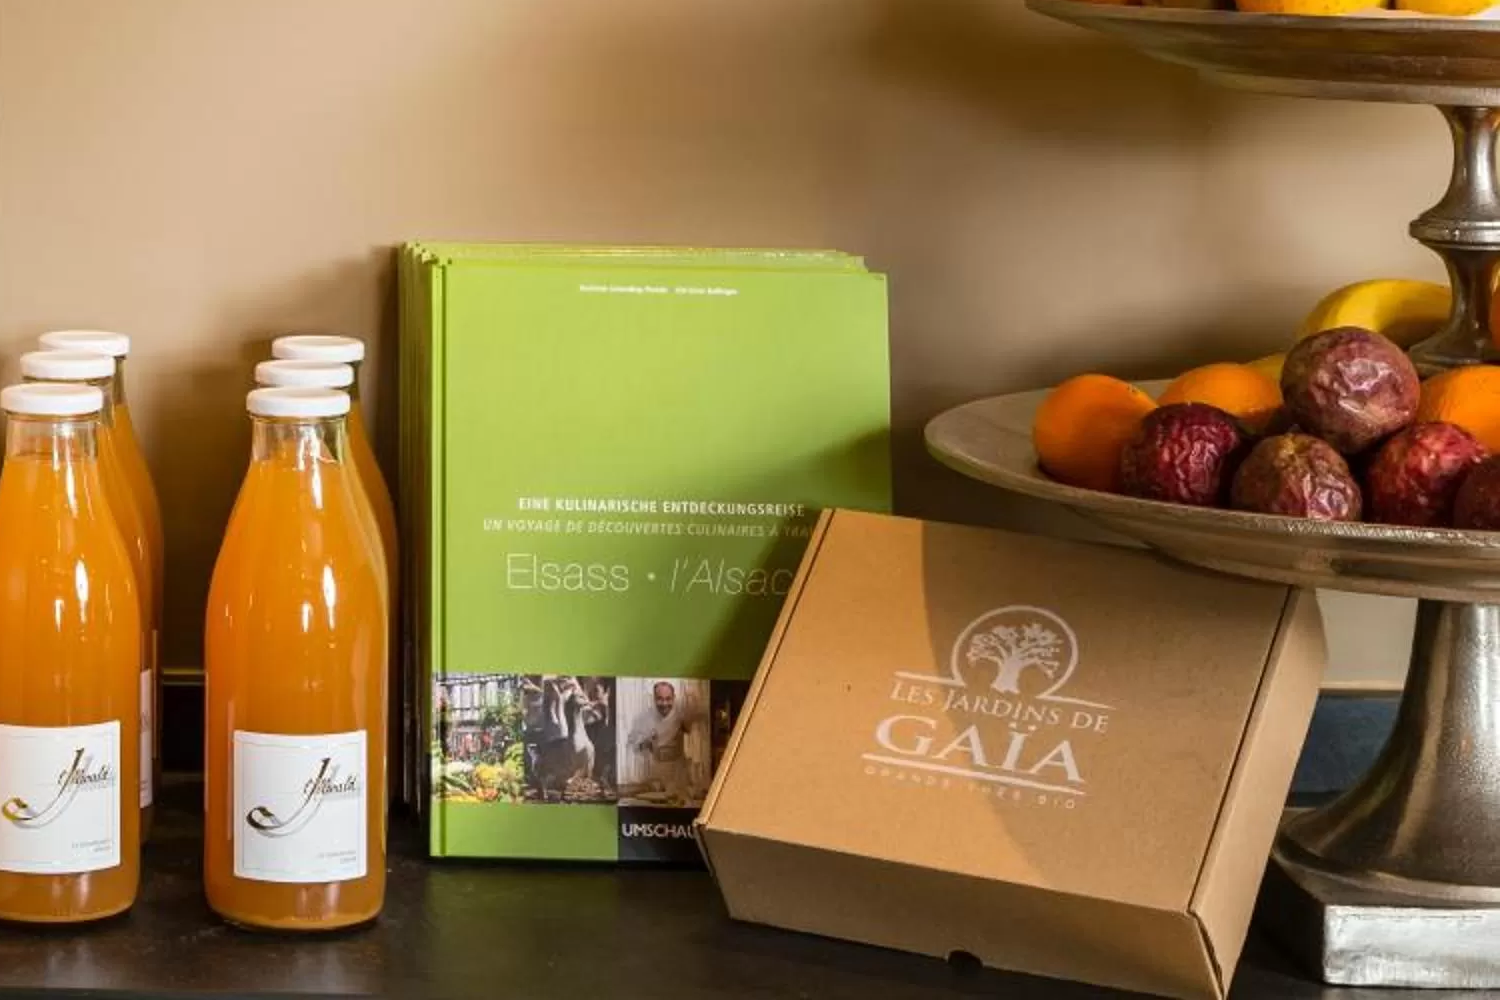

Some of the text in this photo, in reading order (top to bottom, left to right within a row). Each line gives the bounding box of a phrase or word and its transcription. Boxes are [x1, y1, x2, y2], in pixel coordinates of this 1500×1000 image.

[483, 519, 501, 532] UN
[507, 519, 561, 533] VOYAGE
[566, 520, 583, 534] DE
[587, 518, 681, 536] DÉCOUVERTES
[687, 522, 764, 538] CULINAIRES
[518, 497, 805, 518] EINE KULINARISCHE ENTDECKUNGSREISE
[506, 552, 793, 597] Elsass l'Alsac
[889, 680, 1109, 733] LES JARDINS DE
[874, 714, 1086, 784] GAÏA
